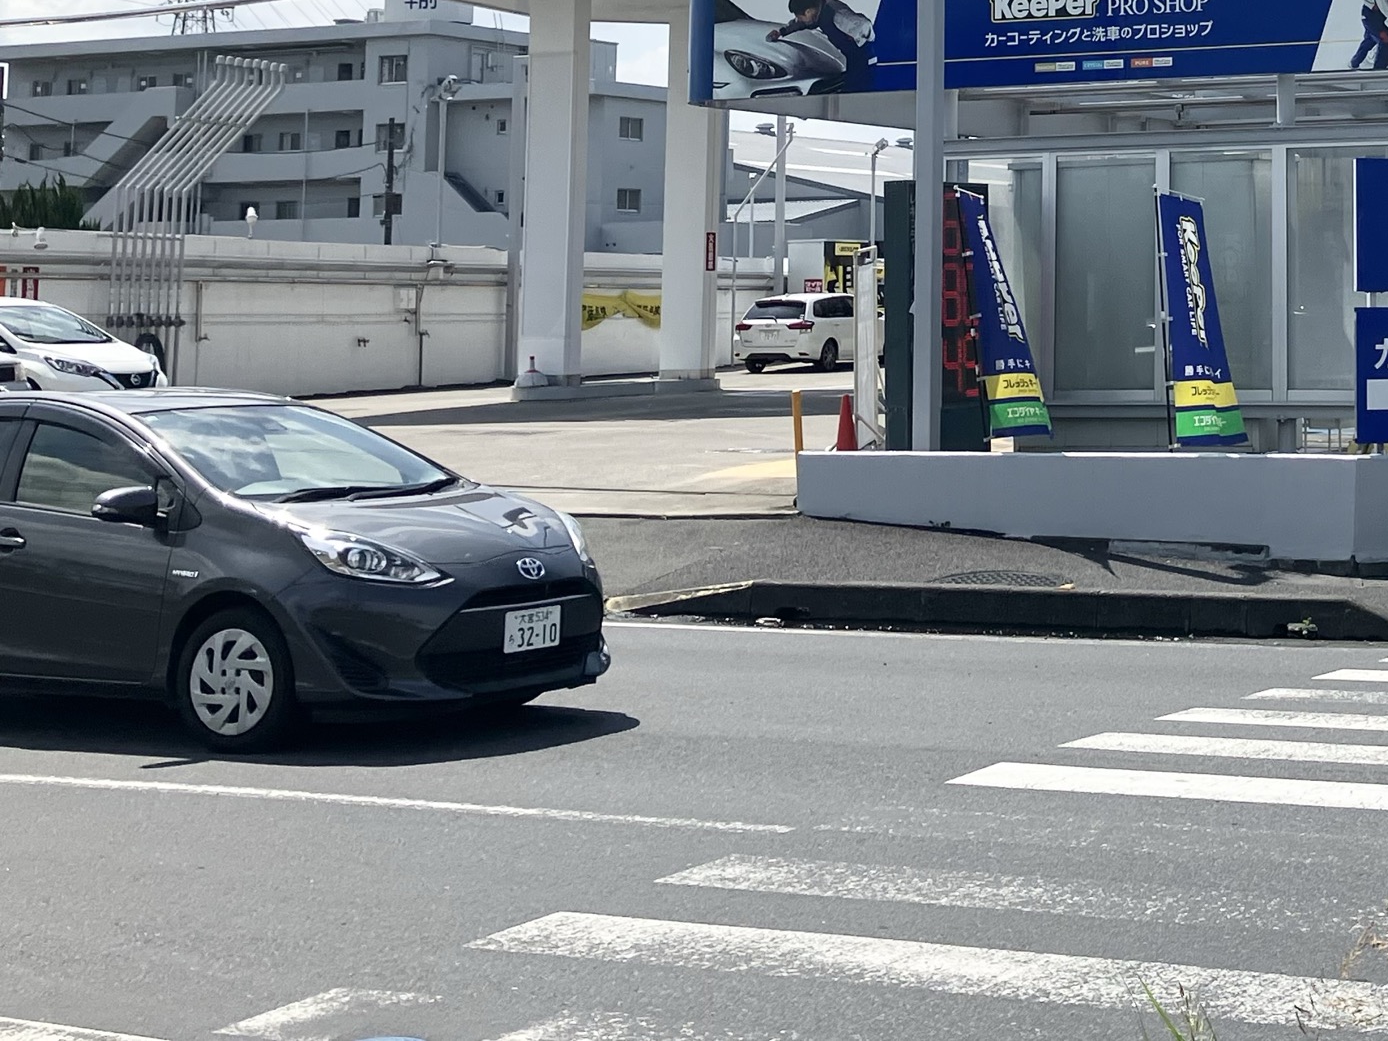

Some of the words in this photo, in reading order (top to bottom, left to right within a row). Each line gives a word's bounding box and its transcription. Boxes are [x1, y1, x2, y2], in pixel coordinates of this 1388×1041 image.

[985, 20, 1213, 47] カーコーティングと洗車のプロショップ
